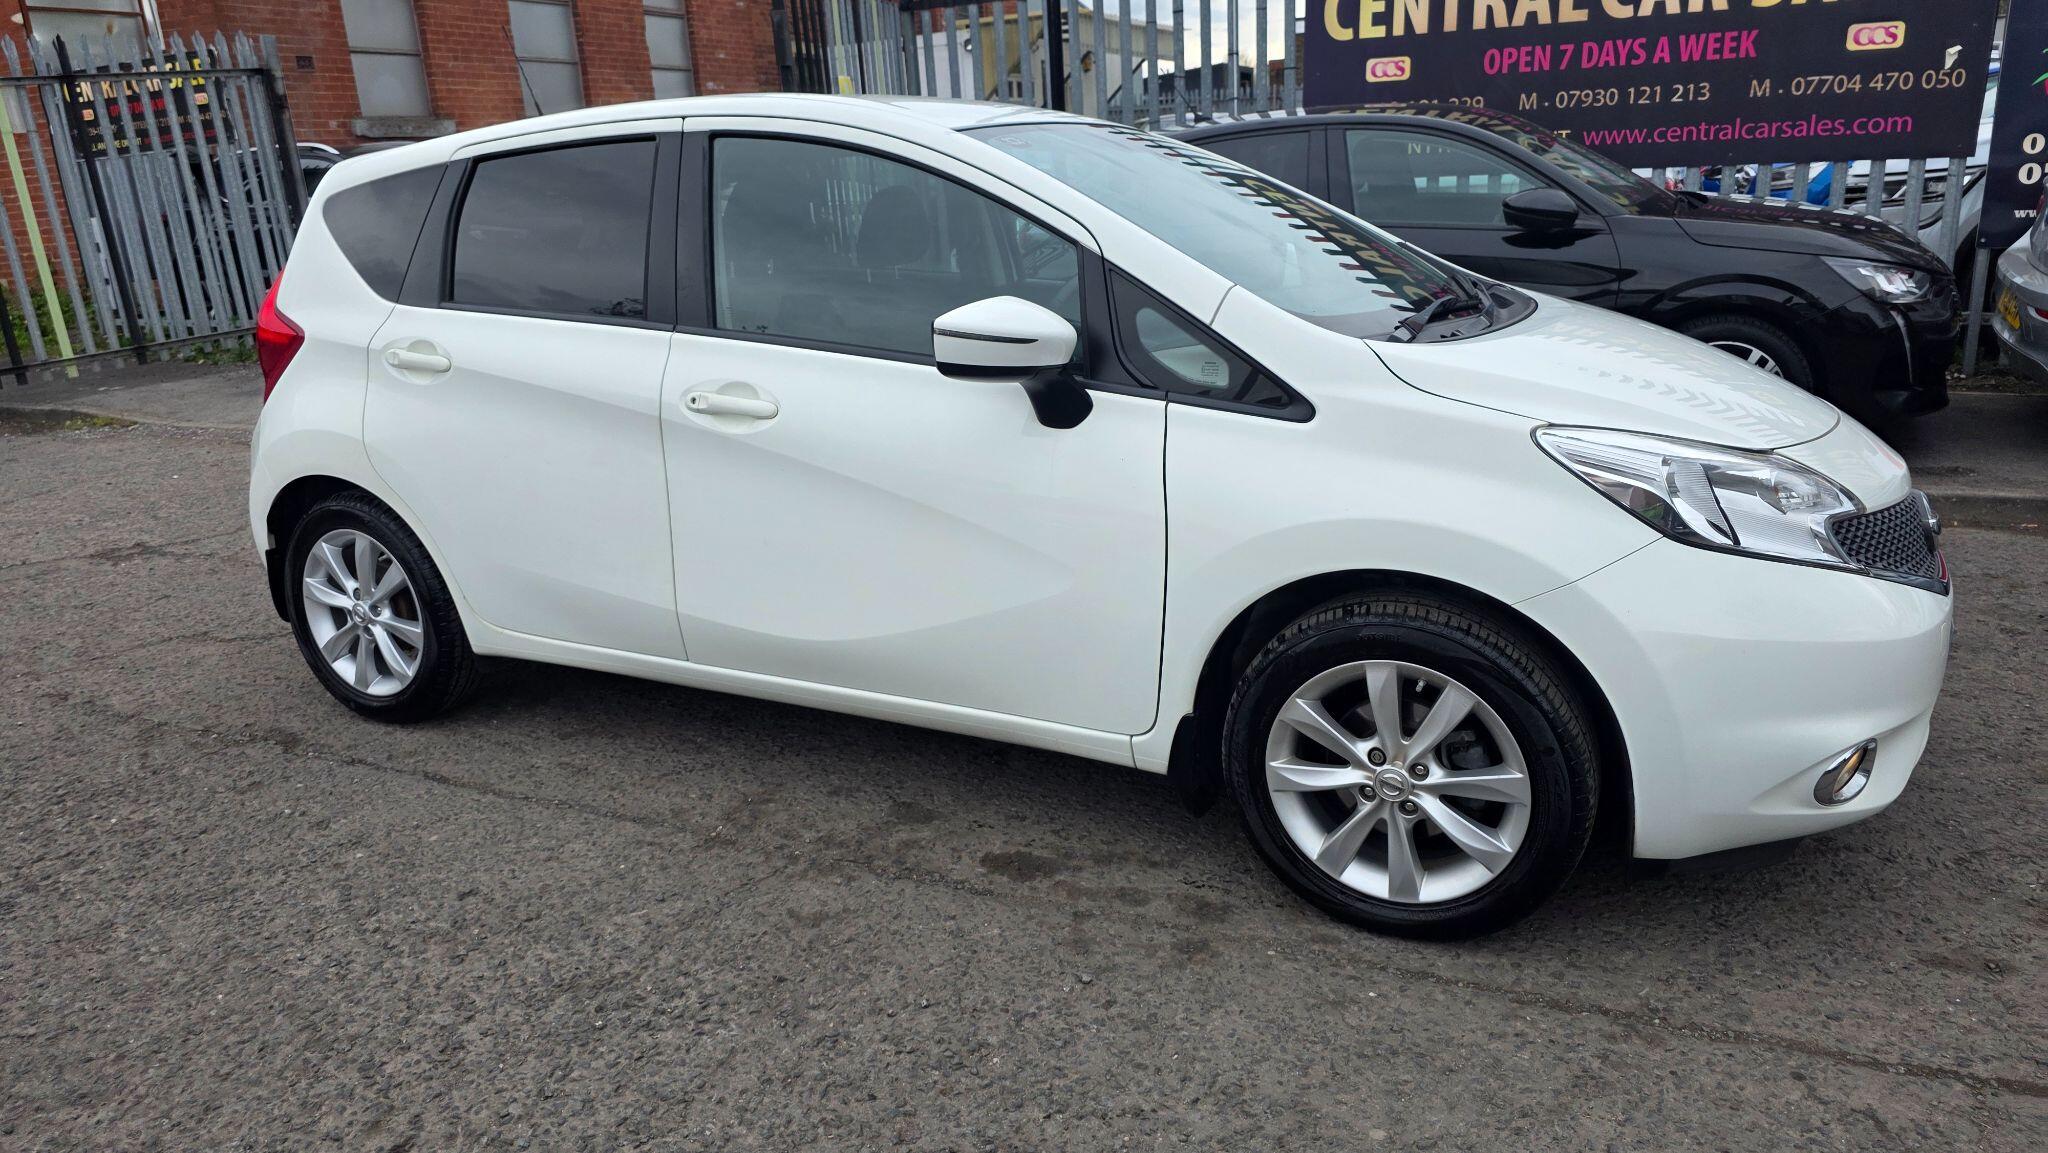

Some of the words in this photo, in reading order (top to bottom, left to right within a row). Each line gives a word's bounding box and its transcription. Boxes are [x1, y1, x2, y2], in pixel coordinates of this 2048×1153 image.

[1853, 25, 1899, 46] CCS
[1483, 45, 1550, 75] OPEN
[1559, 43, 1575, 70] 7
[1580, 37, 1647, 69] DAYS
[1652, 36, 1670, 64] A
[1679, 30, 1760, 62] WEEK
[1370, 59, 1405, 79] CCS
[1749, 78, 1771, 98] M
[1791, 74, 1862, 96] 07704
[1869, 71, 1914, 91] 470
[1921, 68, 1967, 89] 050
[1518, 92, 1537, 111] M
[1555, 87, 1619, 109] 07930
[1627, 84, 1662, 105] 121
[1670, 82, 1711, 102] 213
[1583, 114, 1913, 146] www.centralcarsales.com
